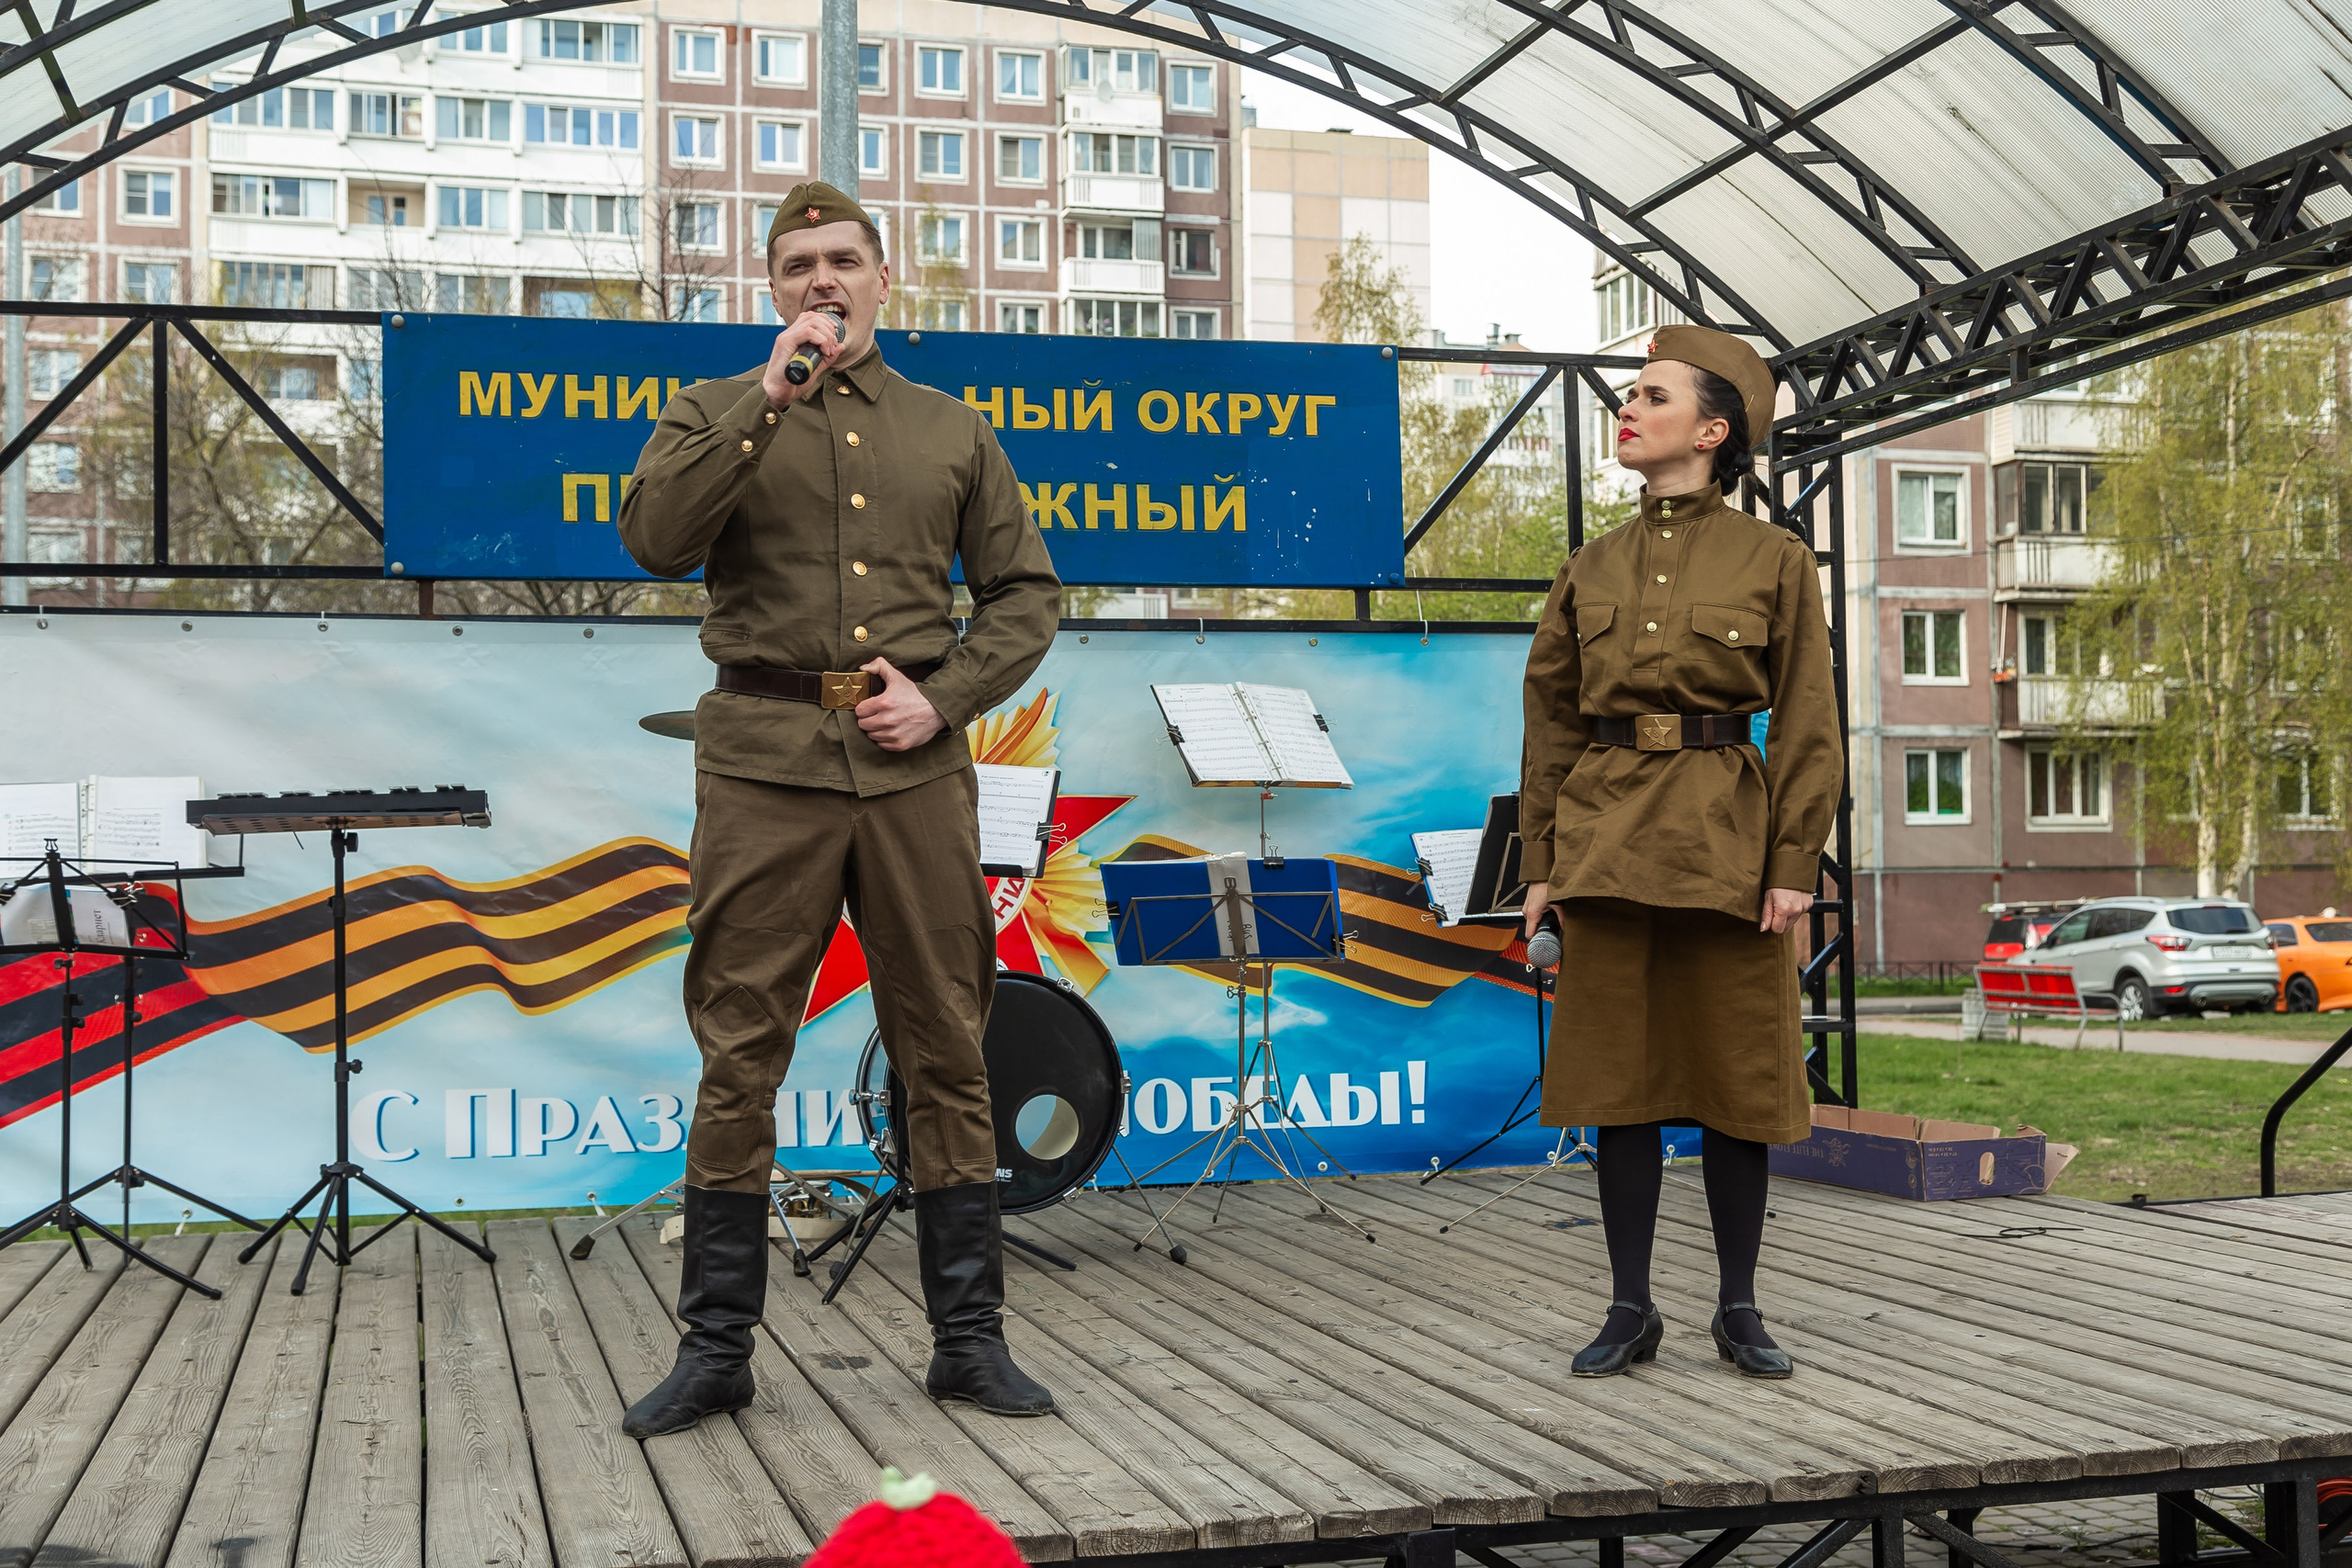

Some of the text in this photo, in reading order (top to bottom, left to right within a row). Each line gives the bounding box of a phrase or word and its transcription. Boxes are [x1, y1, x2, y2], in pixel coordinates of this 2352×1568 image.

[1137, 389, 1337, 437] ОКРУГ
[349, 1089, 419, 1162] С
[1122, 1060, 1426, 1135] ОБЕДЫ!
